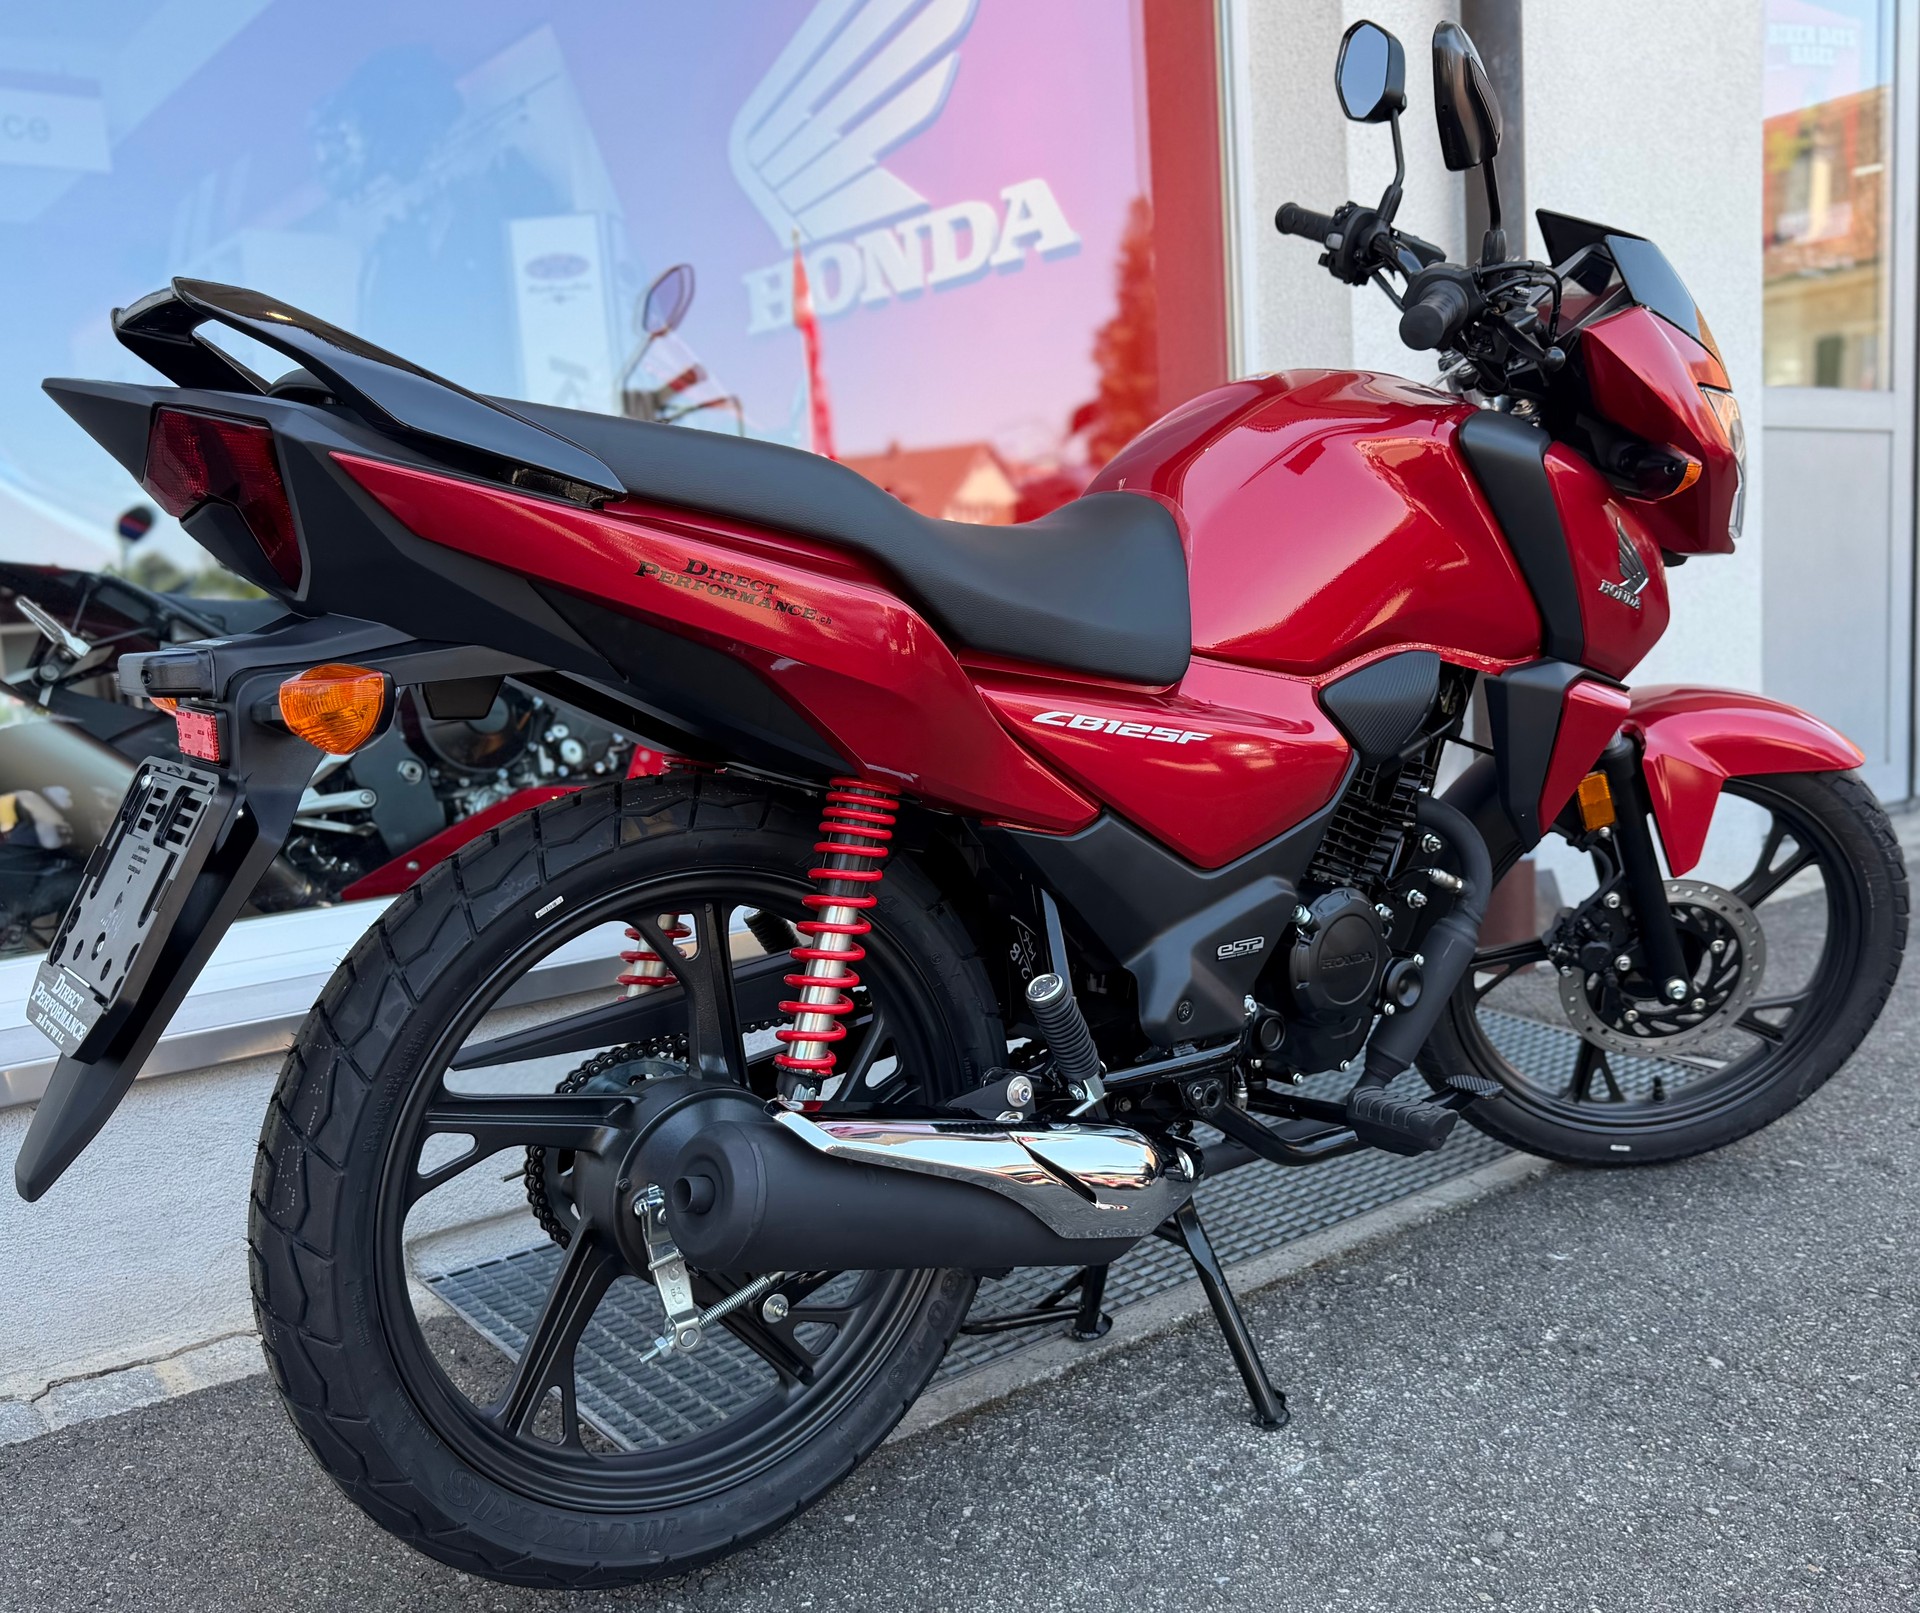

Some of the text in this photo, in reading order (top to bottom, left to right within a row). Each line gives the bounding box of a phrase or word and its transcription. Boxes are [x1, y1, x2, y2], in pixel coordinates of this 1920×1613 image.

[742, 178, 1082, 335] HONDA
[682, 558, 779, 595] DIRECT
[1598, 579, 1641, 609] HONDA
[1032, 711, 1213, 744] CB125F
[1321, 951, 1373, 969] HONDA
[31, 981, 88, 1041] PERFORMANCE
[51, 973, 85, 1012] DIRECT
[441, 1468, 683, 1554] MAXXIS
